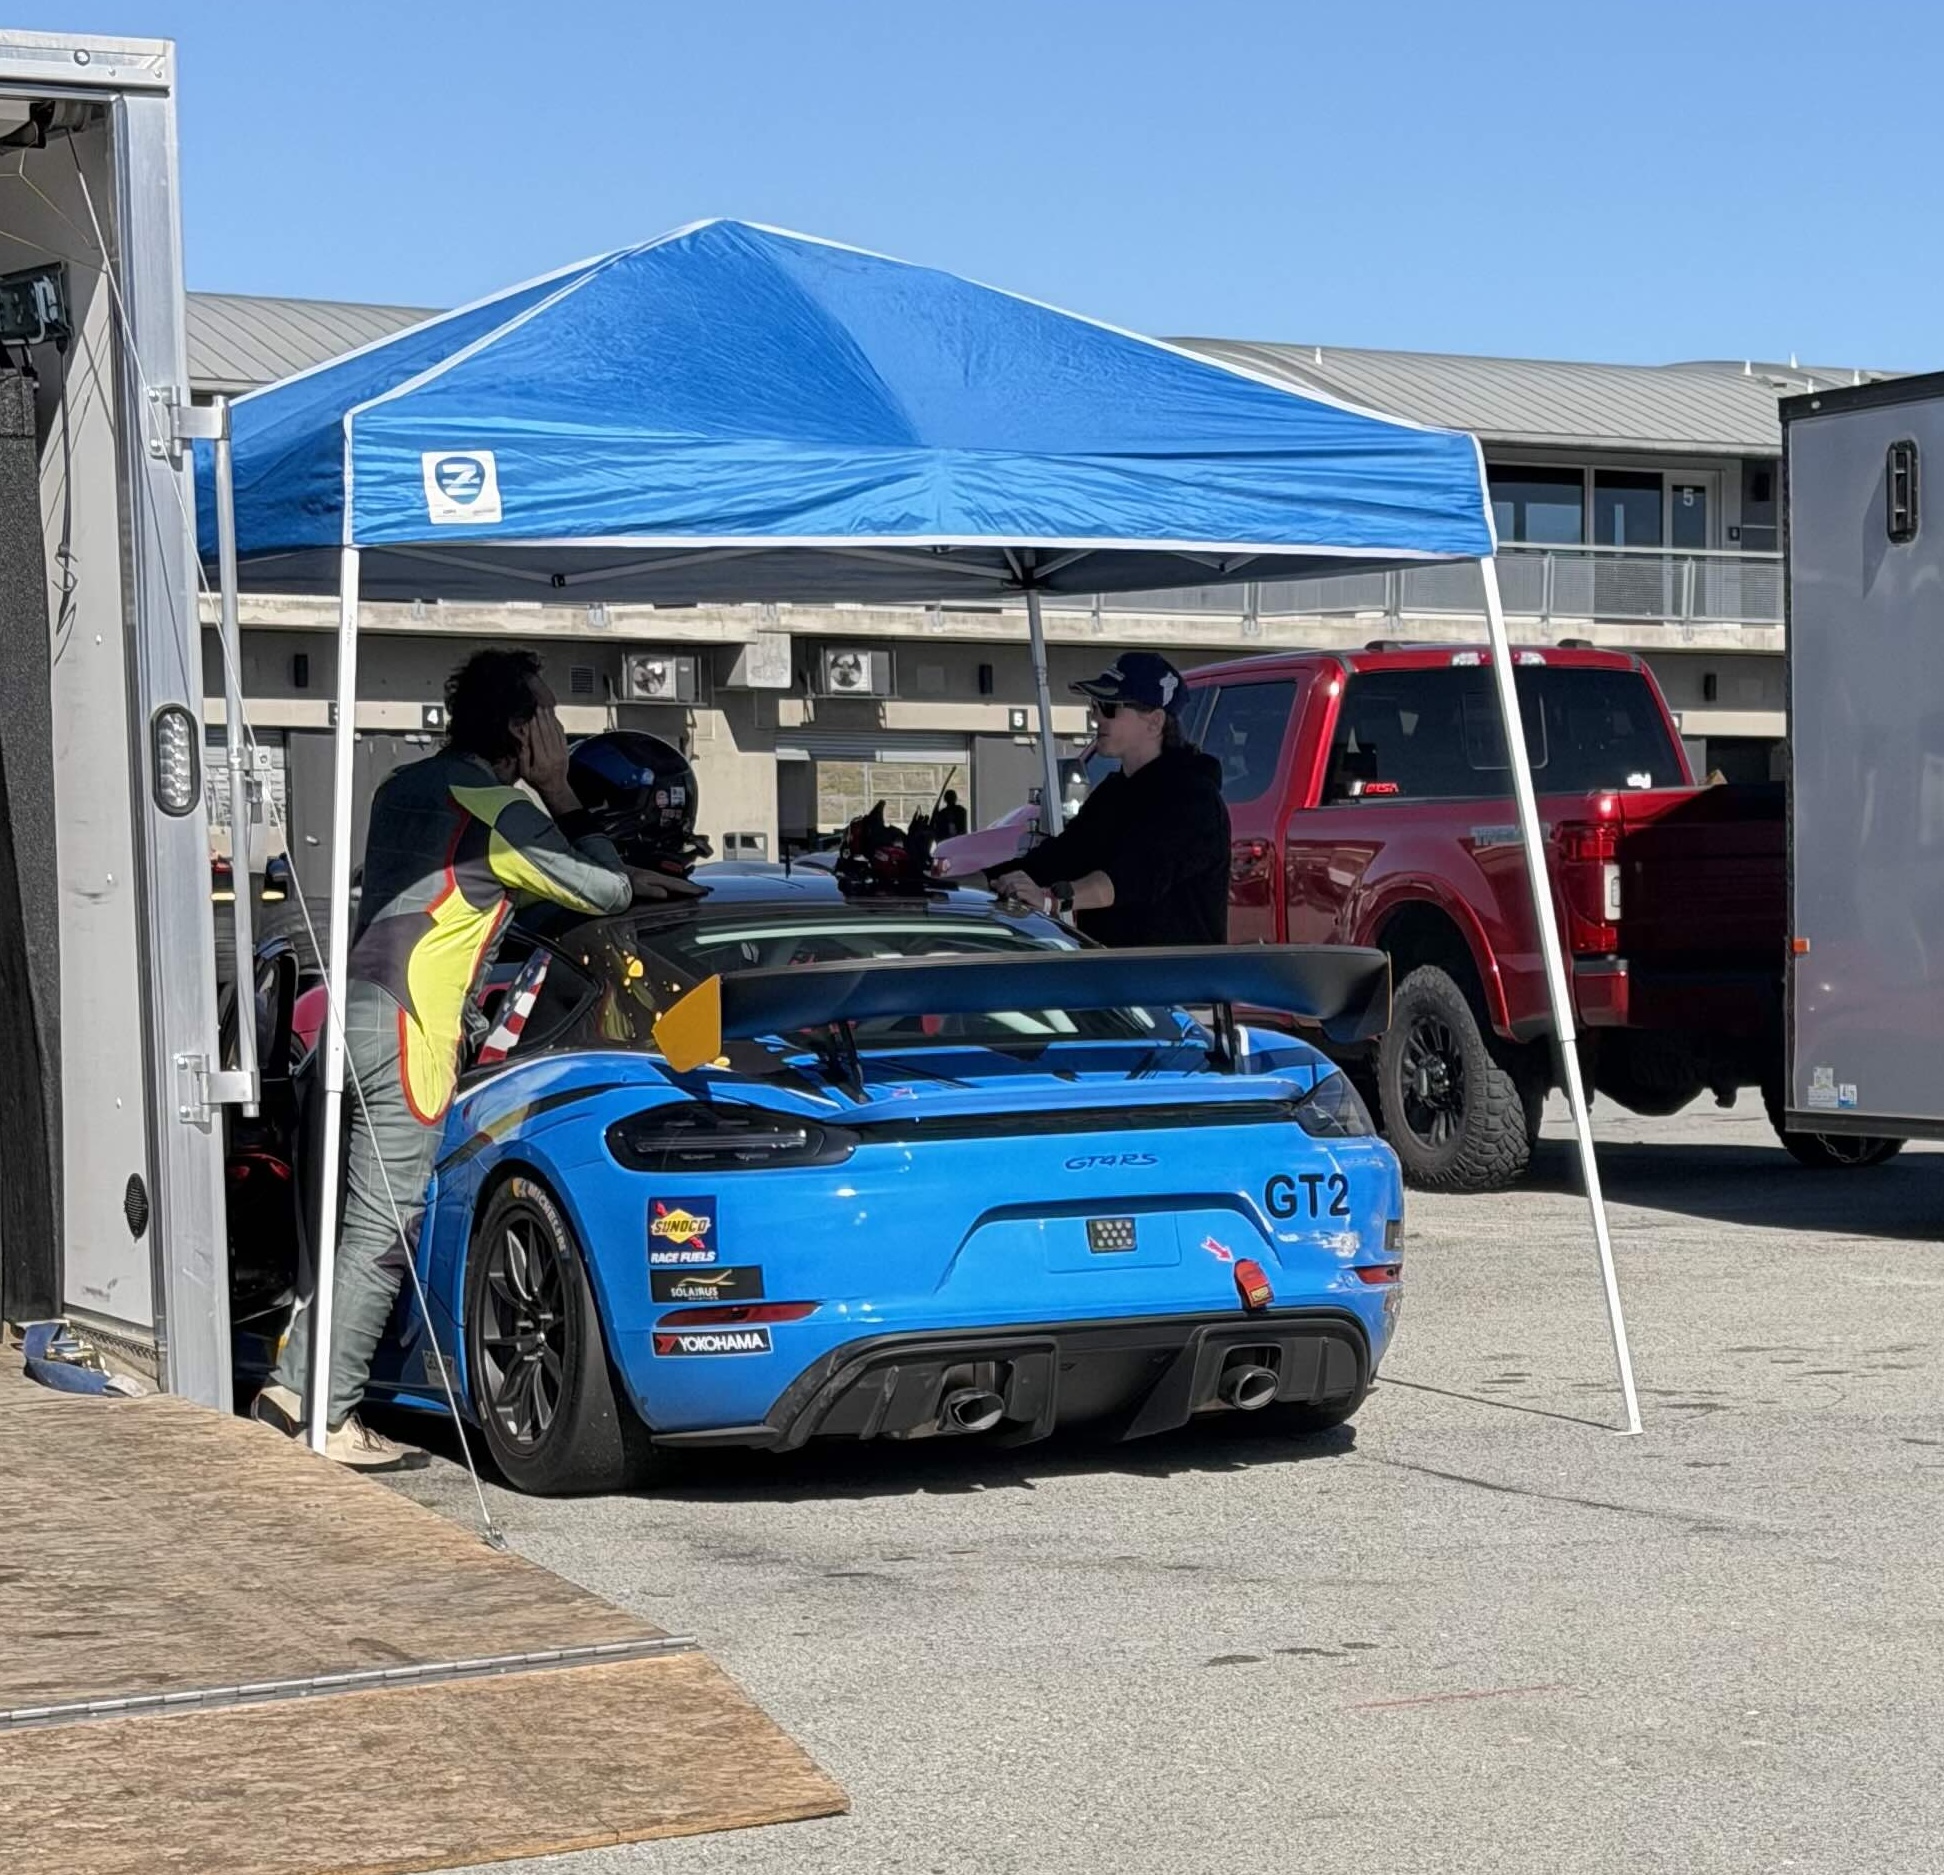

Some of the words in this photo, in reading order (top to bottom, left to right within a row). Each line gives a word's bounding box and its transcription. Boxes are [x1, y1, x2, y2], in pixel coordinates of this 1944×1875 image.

[1683, 488, 1694, 507] 5
[426, 708, 438, 725] 4
[1013, 711, 1024, 727] 5
[1265, 1172, 1350, 1219] GT2
[527, 1182, 567, 1252] MICHELIN
[654, 1219, 707, 1234] SUNOCO
[651, 1252, 679, 1264] RACE
[680, 1251, 716, 1262] FUELS
[670, 1286, 719, 1297] SOLAIRUS
[678, 1332, 765, 1352] YOKOHAMA
